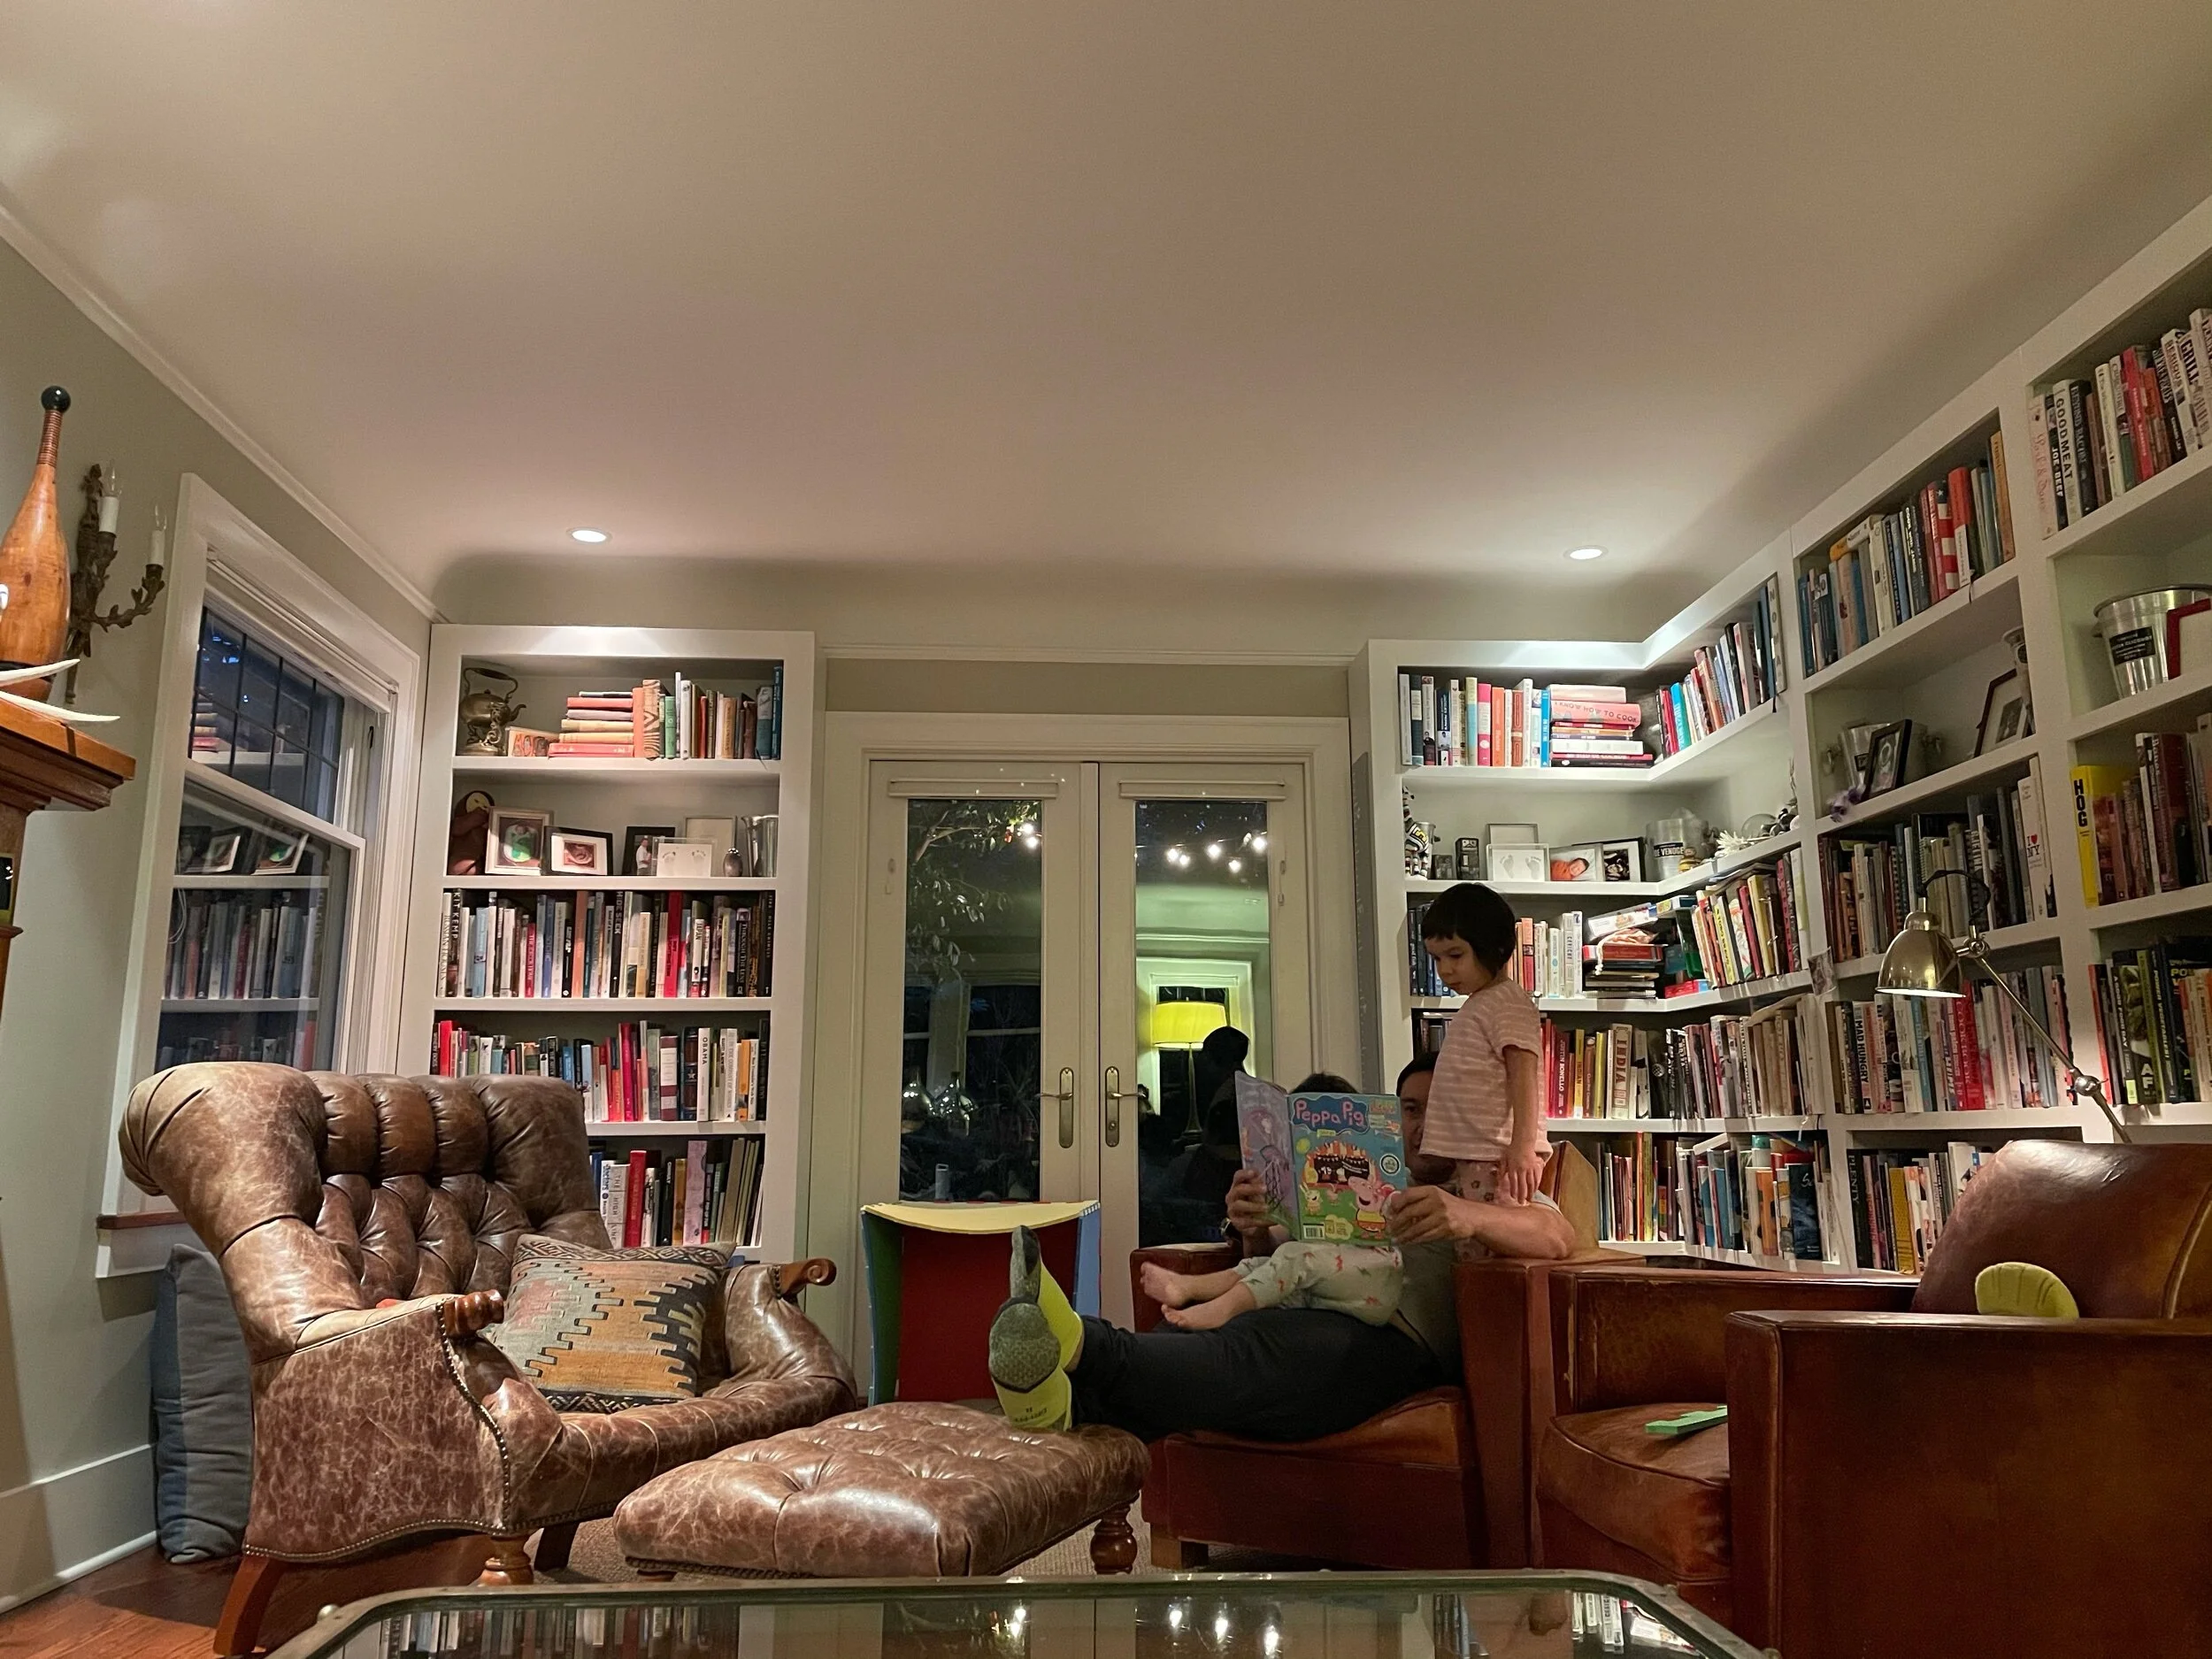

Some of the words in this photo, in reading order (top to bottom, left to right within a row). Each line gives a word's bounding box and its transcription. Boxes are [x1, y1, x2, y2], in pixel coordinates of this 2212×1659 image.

[2165, 340, 2183, 388] SERIOUS
[2180, 339, 2200, 386] GRILL
[2051, 447, 2061, 466] JOE
[2054, 471, 2063, 497] BEEF
[1617, 713, 1637, 723] COOK
[2072, 780, 2088, 827] HOG
[2027, 844, 2039, 857] NY
[442, 915, 450, 947] RUSSIAN
[695, 923, 704, 940] JAPAN
[441, 949, 449, 980] HOUSES
[2153, 970, 2162, 1001] POWER
[1855, 1020, 1864, 1041] MAD
[1949, 1032, 1958, 1054] paleo
[2157, 1002, 2170, 1058] VEGETABLES!
[1616, 1039, 1627, 1084] INDIA
[1857, 1043, 1869, 1083] HUNGRY
[1294, 1098, 1341, 1128] Peppa
[1341, 1100, 1365, 1128] Pig
[1848, 1154, 1860, 1204] PLENTY
